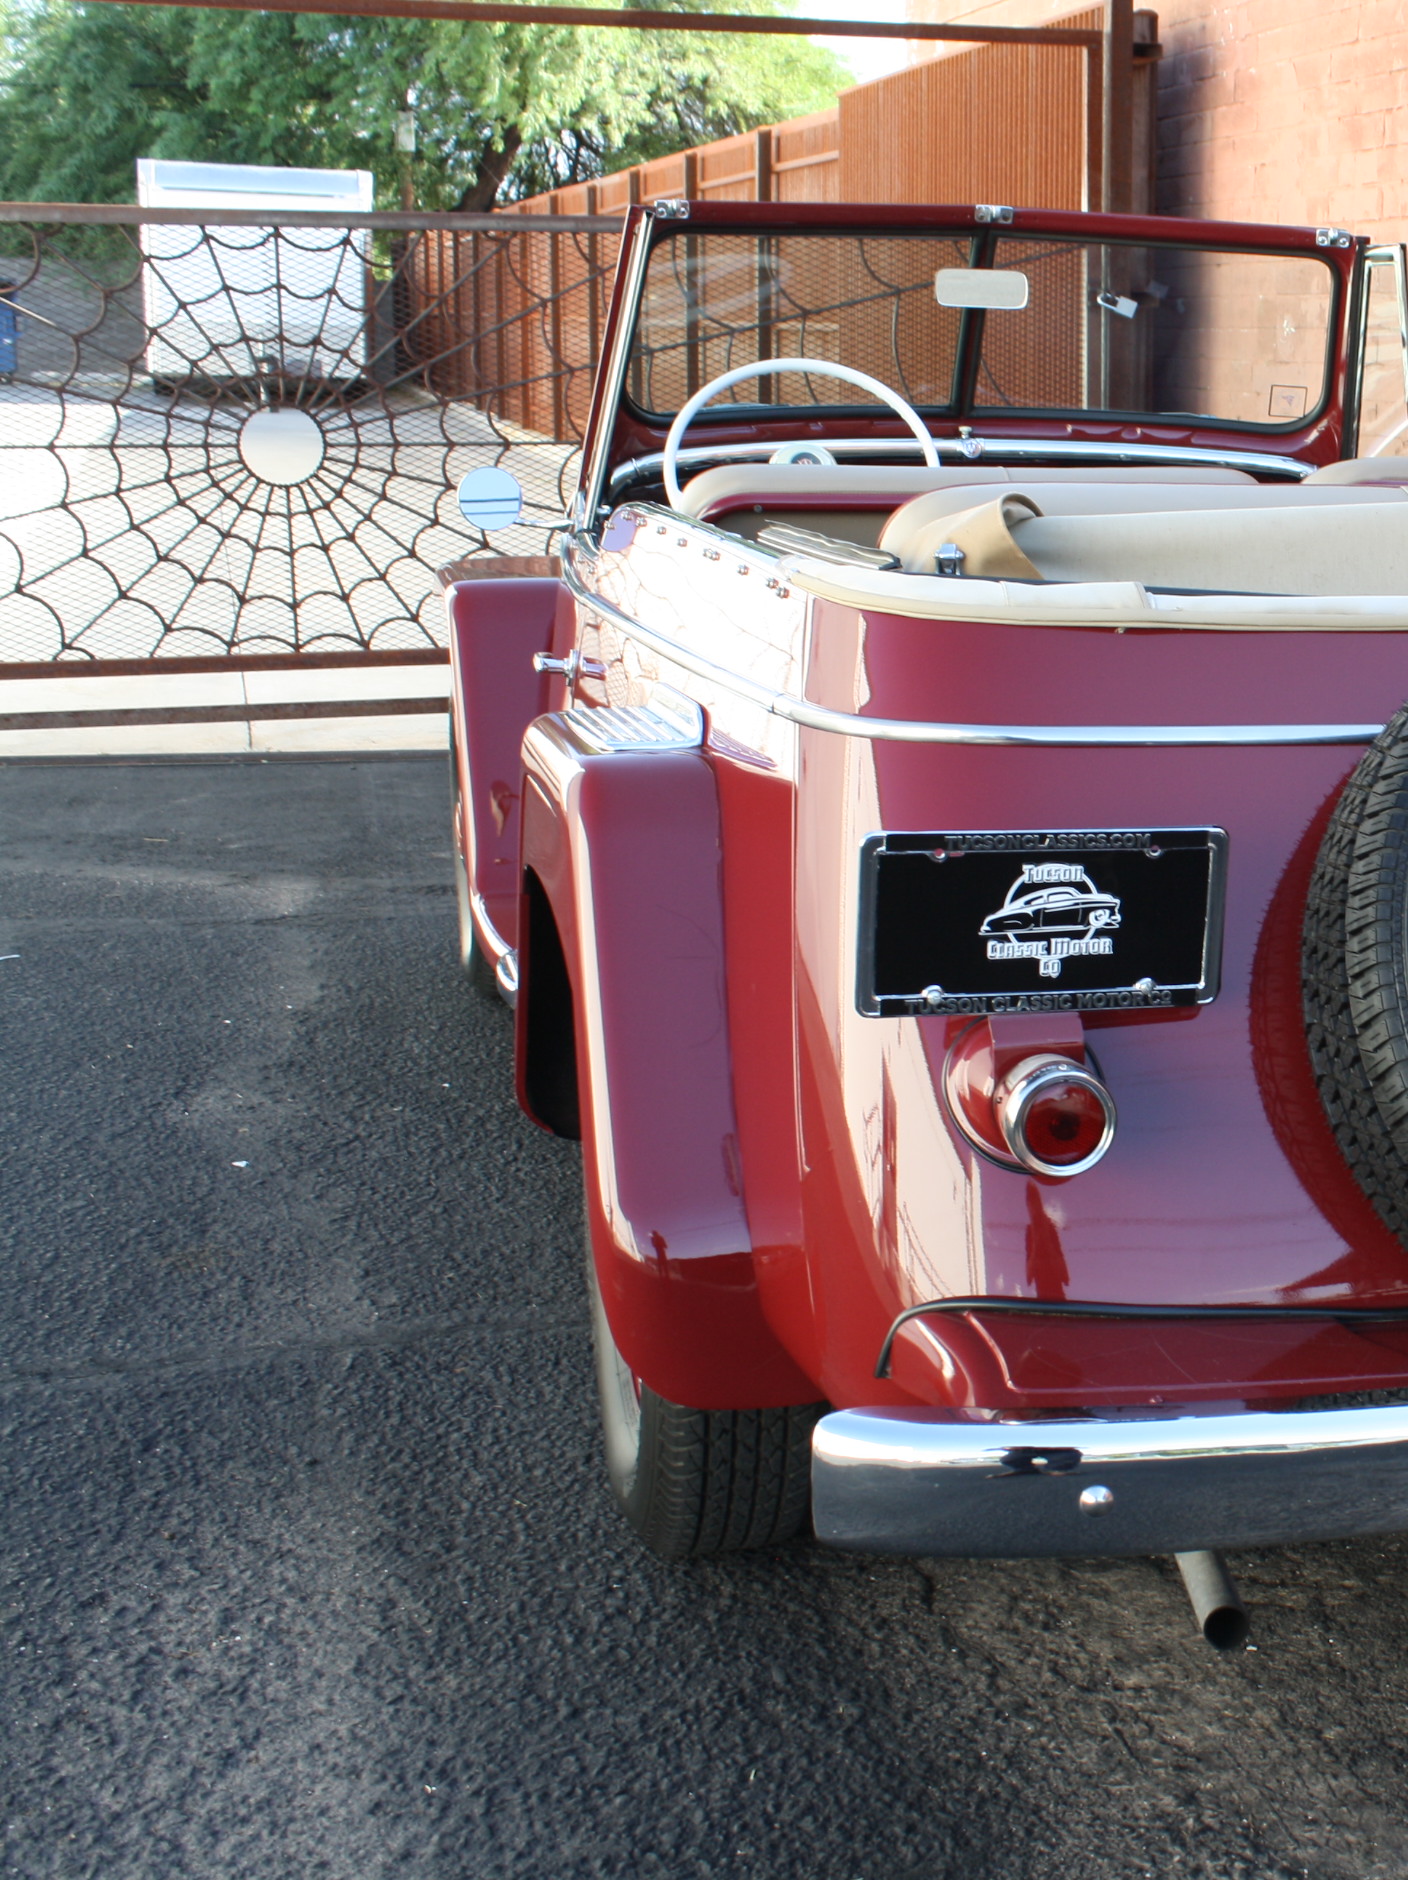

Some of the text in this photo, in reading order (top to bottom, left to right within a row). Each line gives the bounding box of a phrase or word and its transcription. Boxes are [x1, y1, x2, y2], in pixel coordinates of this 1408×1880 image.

[944, 833, 1151, 850] TUCSONCLASSICS.COM
[1021, 863, 1085, 884] TUCSON
[986, 936, 1114, 960] CLASSIC MOTOR
[1038, 957, 1062, 979] CO
[905, 997, 987, 1016] TUCSON
[991, 993, 1073, 1013] CLASSIC
[1075, 989, 1145, 1010] MOTOR
